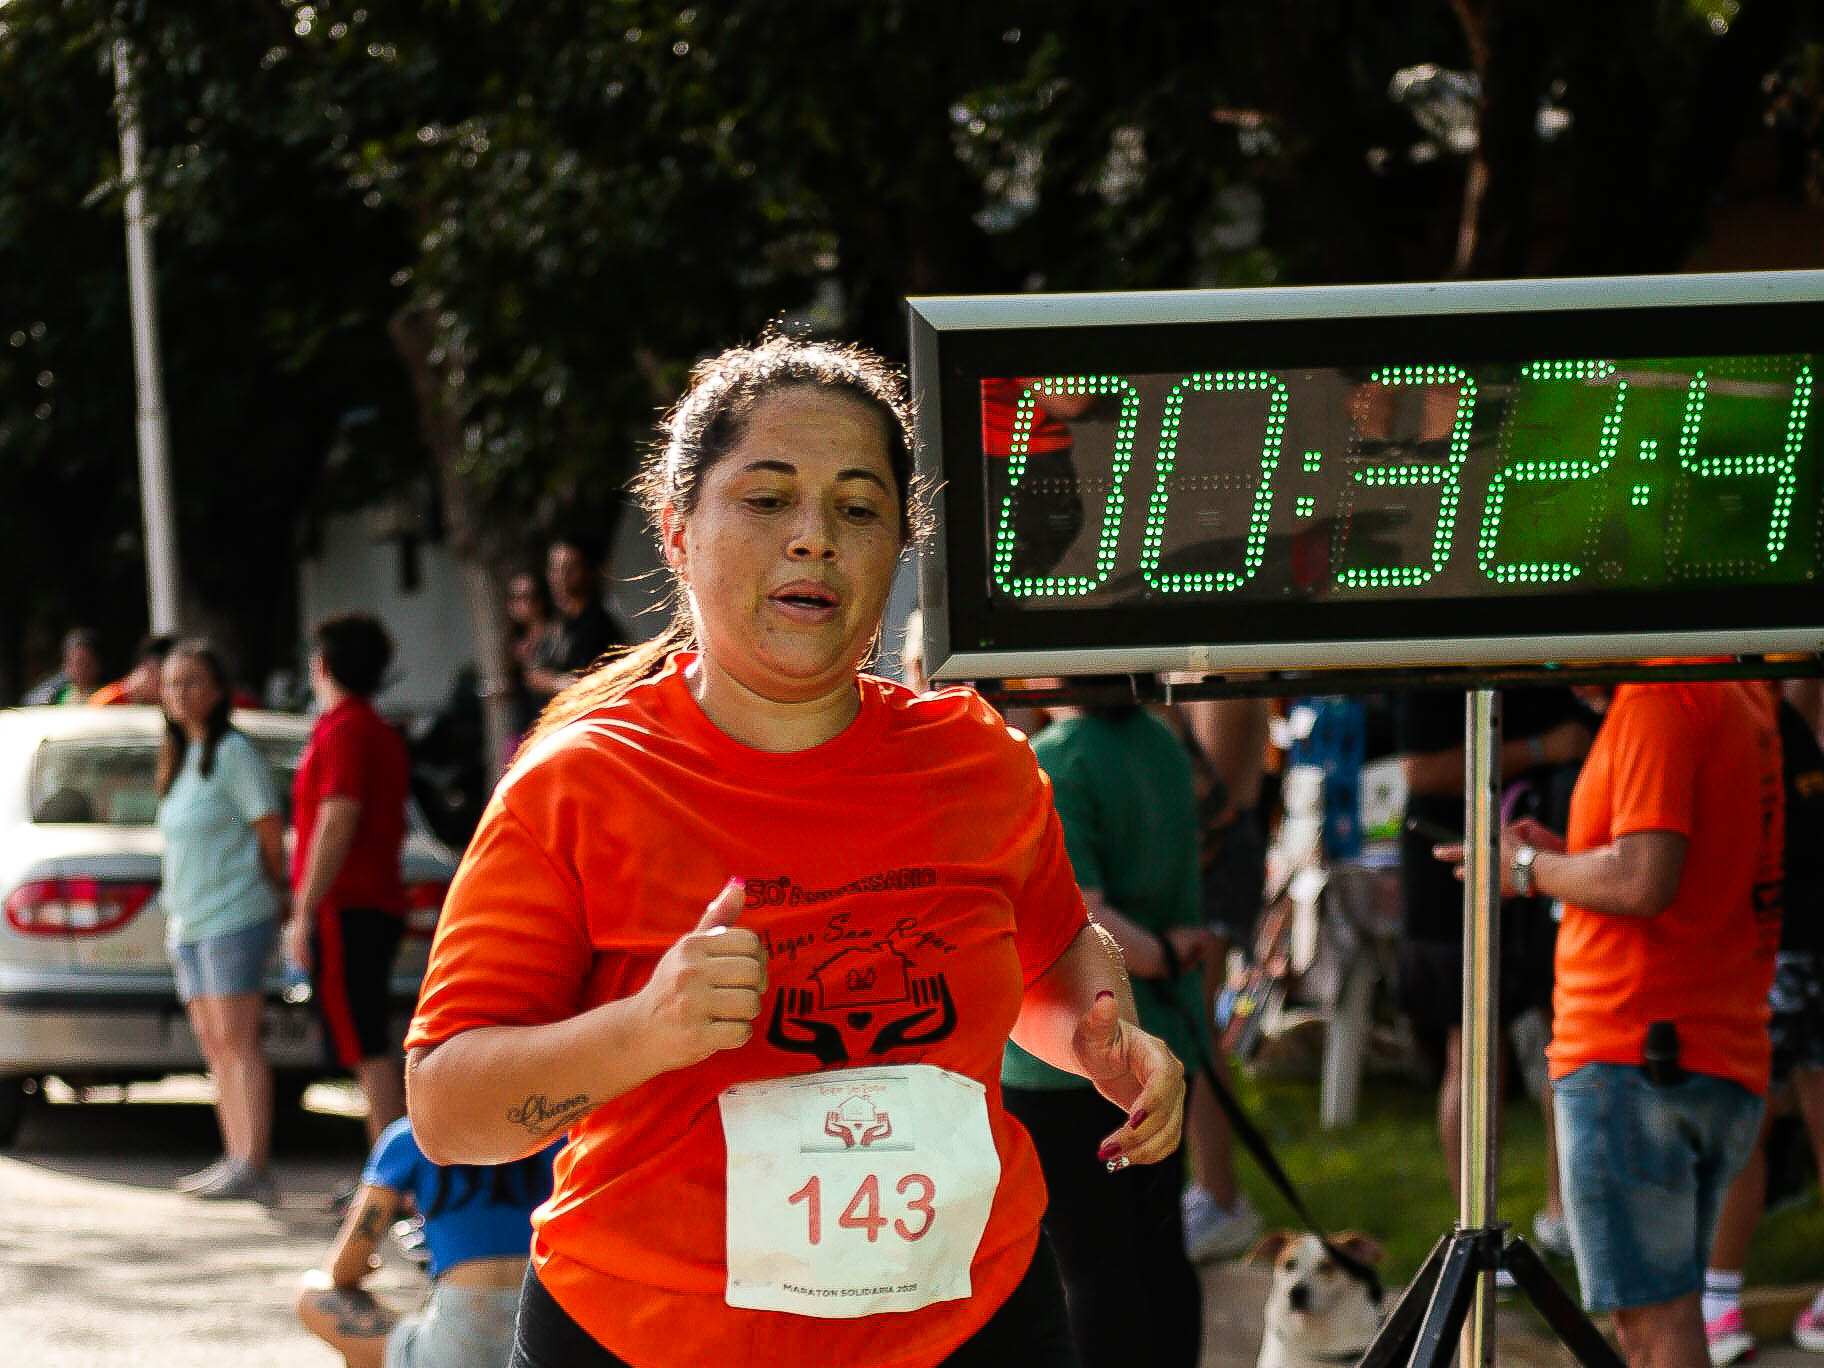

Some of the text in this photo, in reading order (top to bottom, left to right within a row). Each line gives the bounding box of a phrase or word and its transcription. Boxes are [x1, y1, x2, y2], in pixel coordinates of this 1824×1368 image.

[788, 1173, 937, 1246] 143
[783, 1283, 838, 1298] MARATON
[840, 1286, 895, 1298] SOLIDARIA
